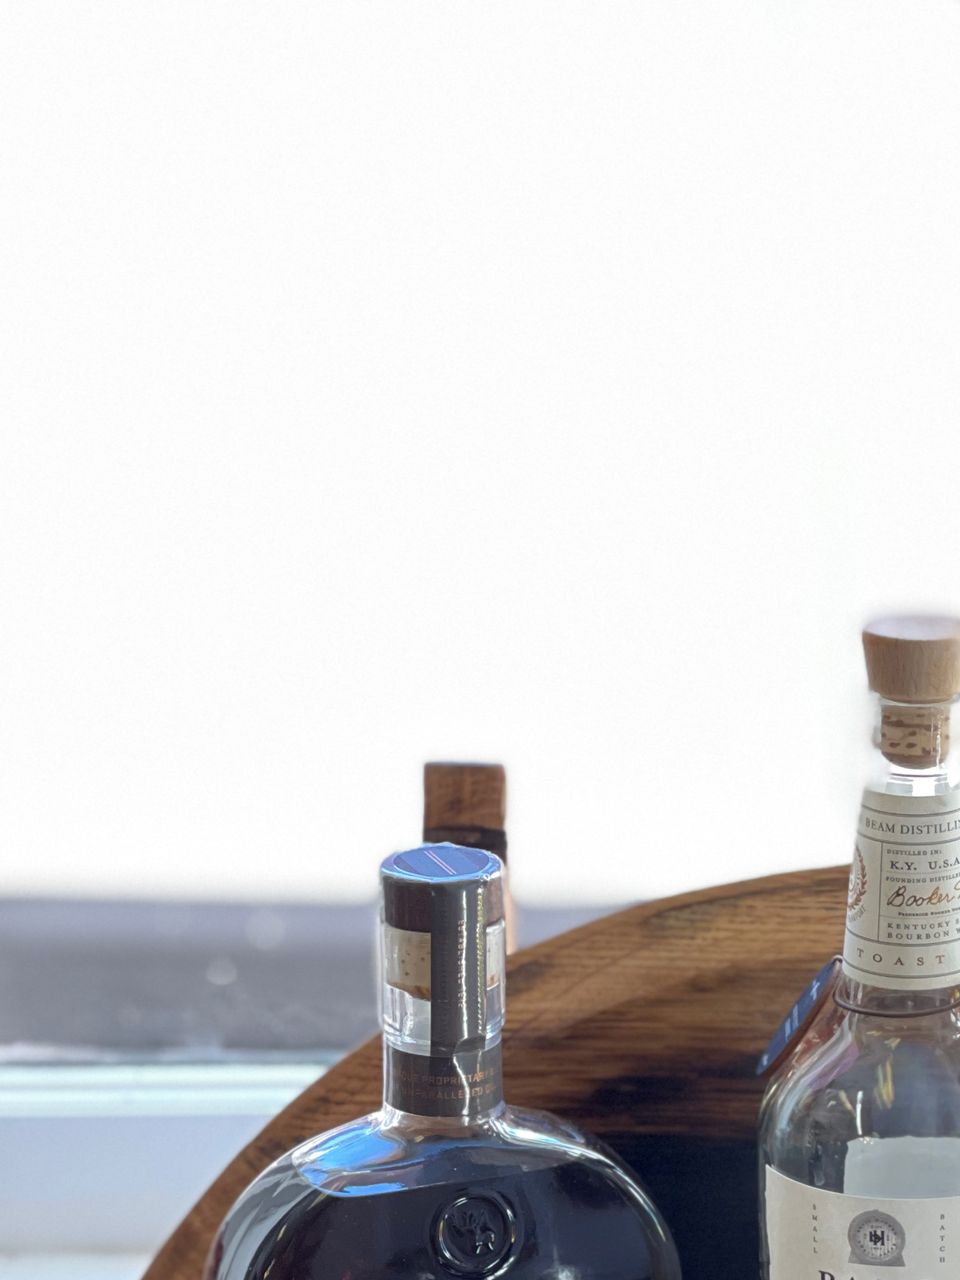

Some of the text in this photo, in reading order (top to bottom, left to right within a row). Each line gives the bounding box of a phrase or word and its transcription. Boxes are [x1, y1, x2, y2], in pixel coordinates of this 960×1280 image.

[865, 817, 895, 833] BEAM
[890, 860, 918, 871] K.Y.
[887, 920, 951, 931] KENTUCKY
[887, 930, 951, 940] BOURBON
[856, 947, 946, 967] TOAST
[938, 1213, 946, 1264] BATCH
